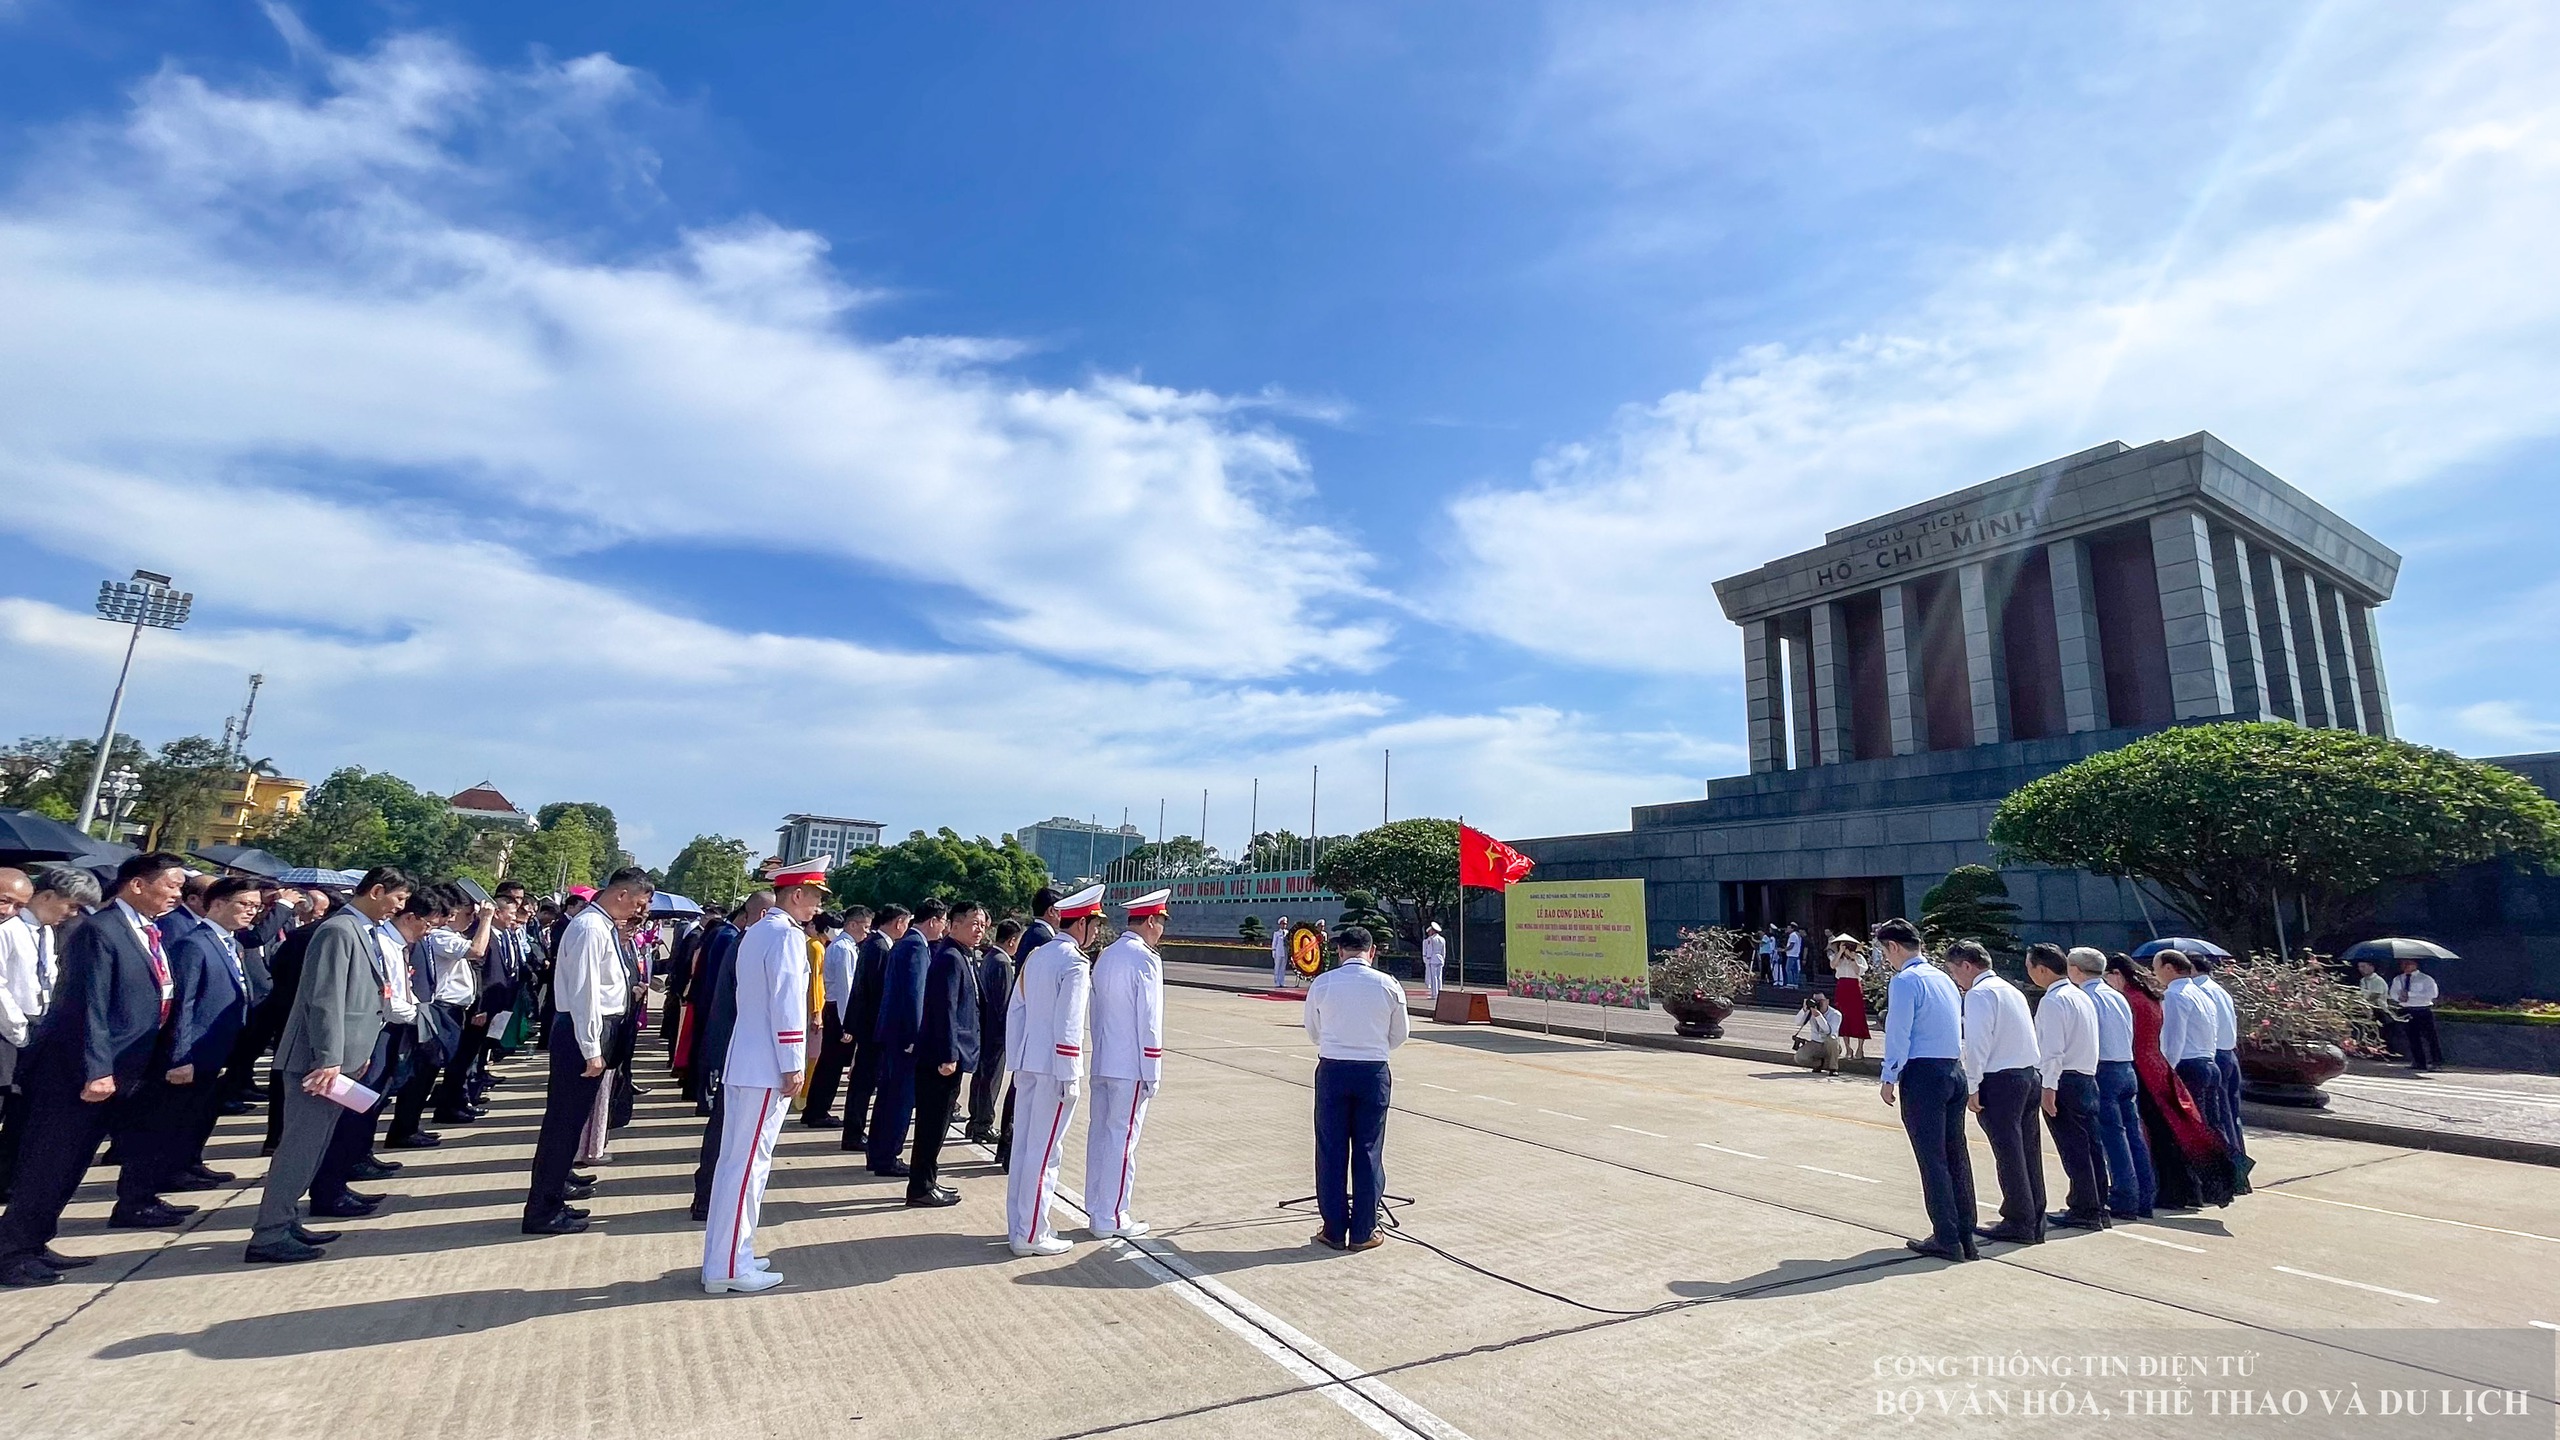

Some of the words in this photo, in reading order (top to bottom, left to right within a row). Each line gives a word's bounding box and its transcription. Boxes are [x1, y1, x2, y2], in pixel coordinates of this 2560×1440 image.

[1950, 508, 2039, 549] MINH
[1230, 876, 1252, 898] VIỆT
[1256, 877, 1281, 895] NAM
